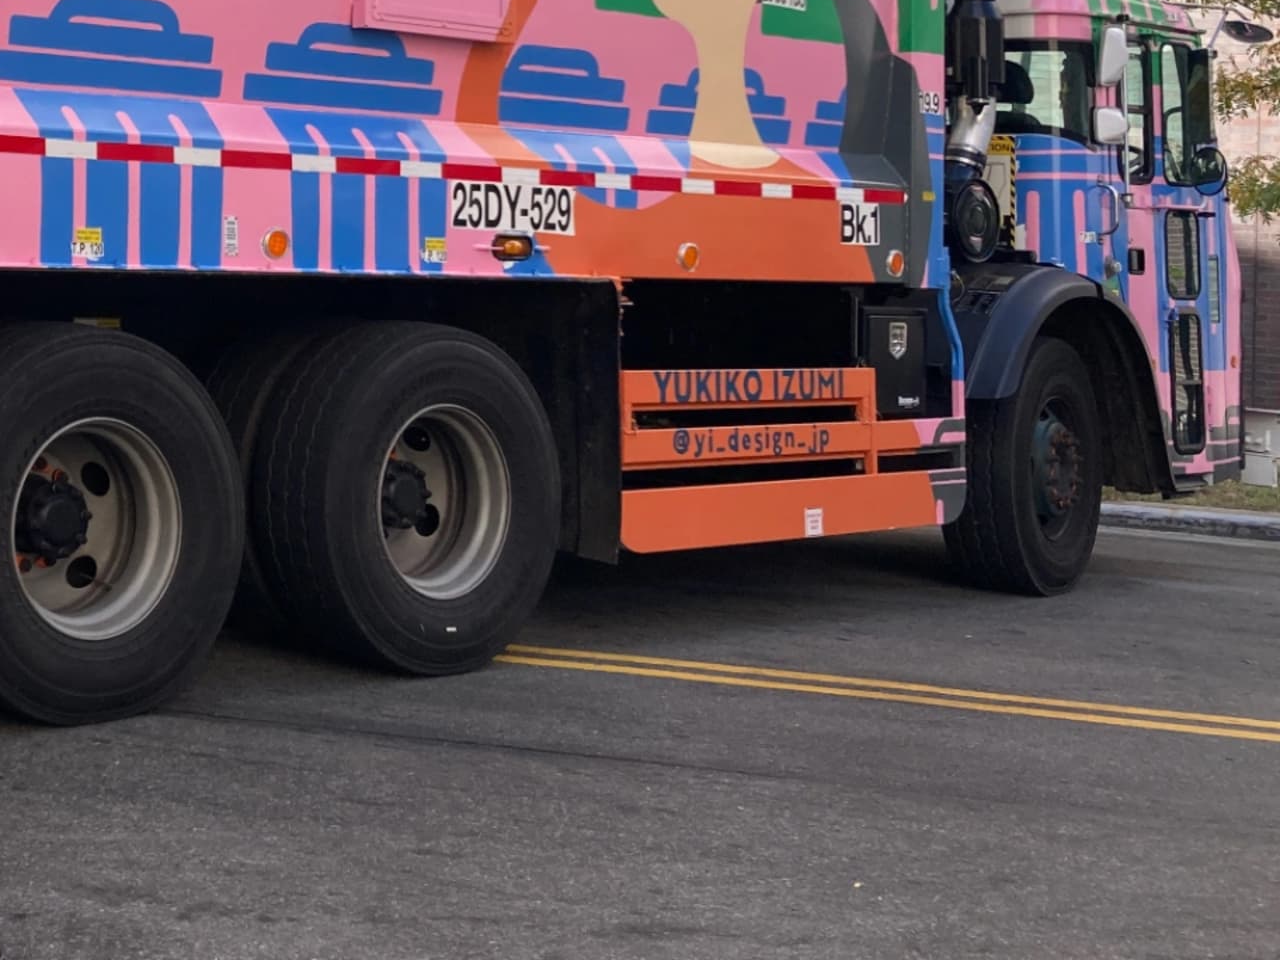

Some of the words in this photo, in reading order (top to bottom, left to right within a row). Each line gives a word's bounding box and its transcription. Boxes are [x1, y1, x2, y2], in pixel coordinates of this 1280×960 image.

[452, 182, 571, 231] 25DY-529
[841, 204, 878, 243] Bk.1
[653, 370, 763, 404] YUKIKO
[773, 369, 844, 401] IZUMI
[673, 424, 830, 458] @yi_design_jp
